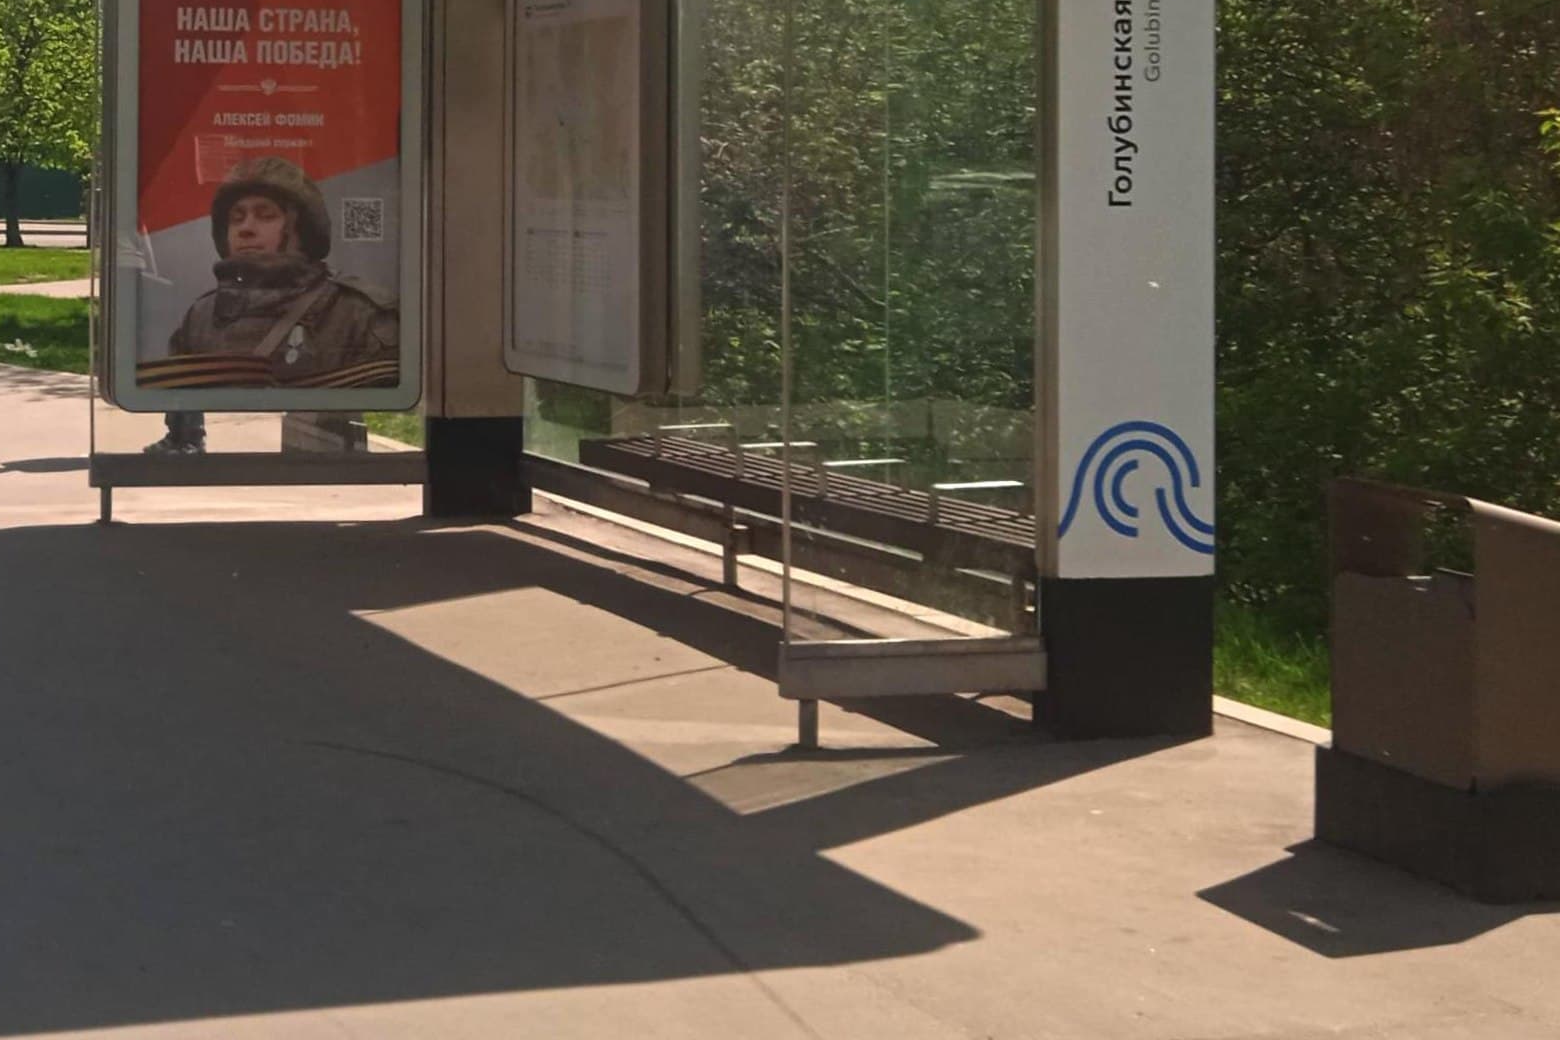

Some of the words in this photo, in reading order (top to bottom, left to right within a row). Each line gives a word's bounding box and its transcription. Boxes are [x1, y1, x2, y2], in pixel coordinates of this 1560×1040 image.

[177, 7, 251, 32] НАША
[259, 8, 360, 37] СТРАНА,
[174, 39, 249, 64] НАША
[256, 40, 362, 69] ПОБЕДА!
[1107, 0, 1138, 207] Голубинская
